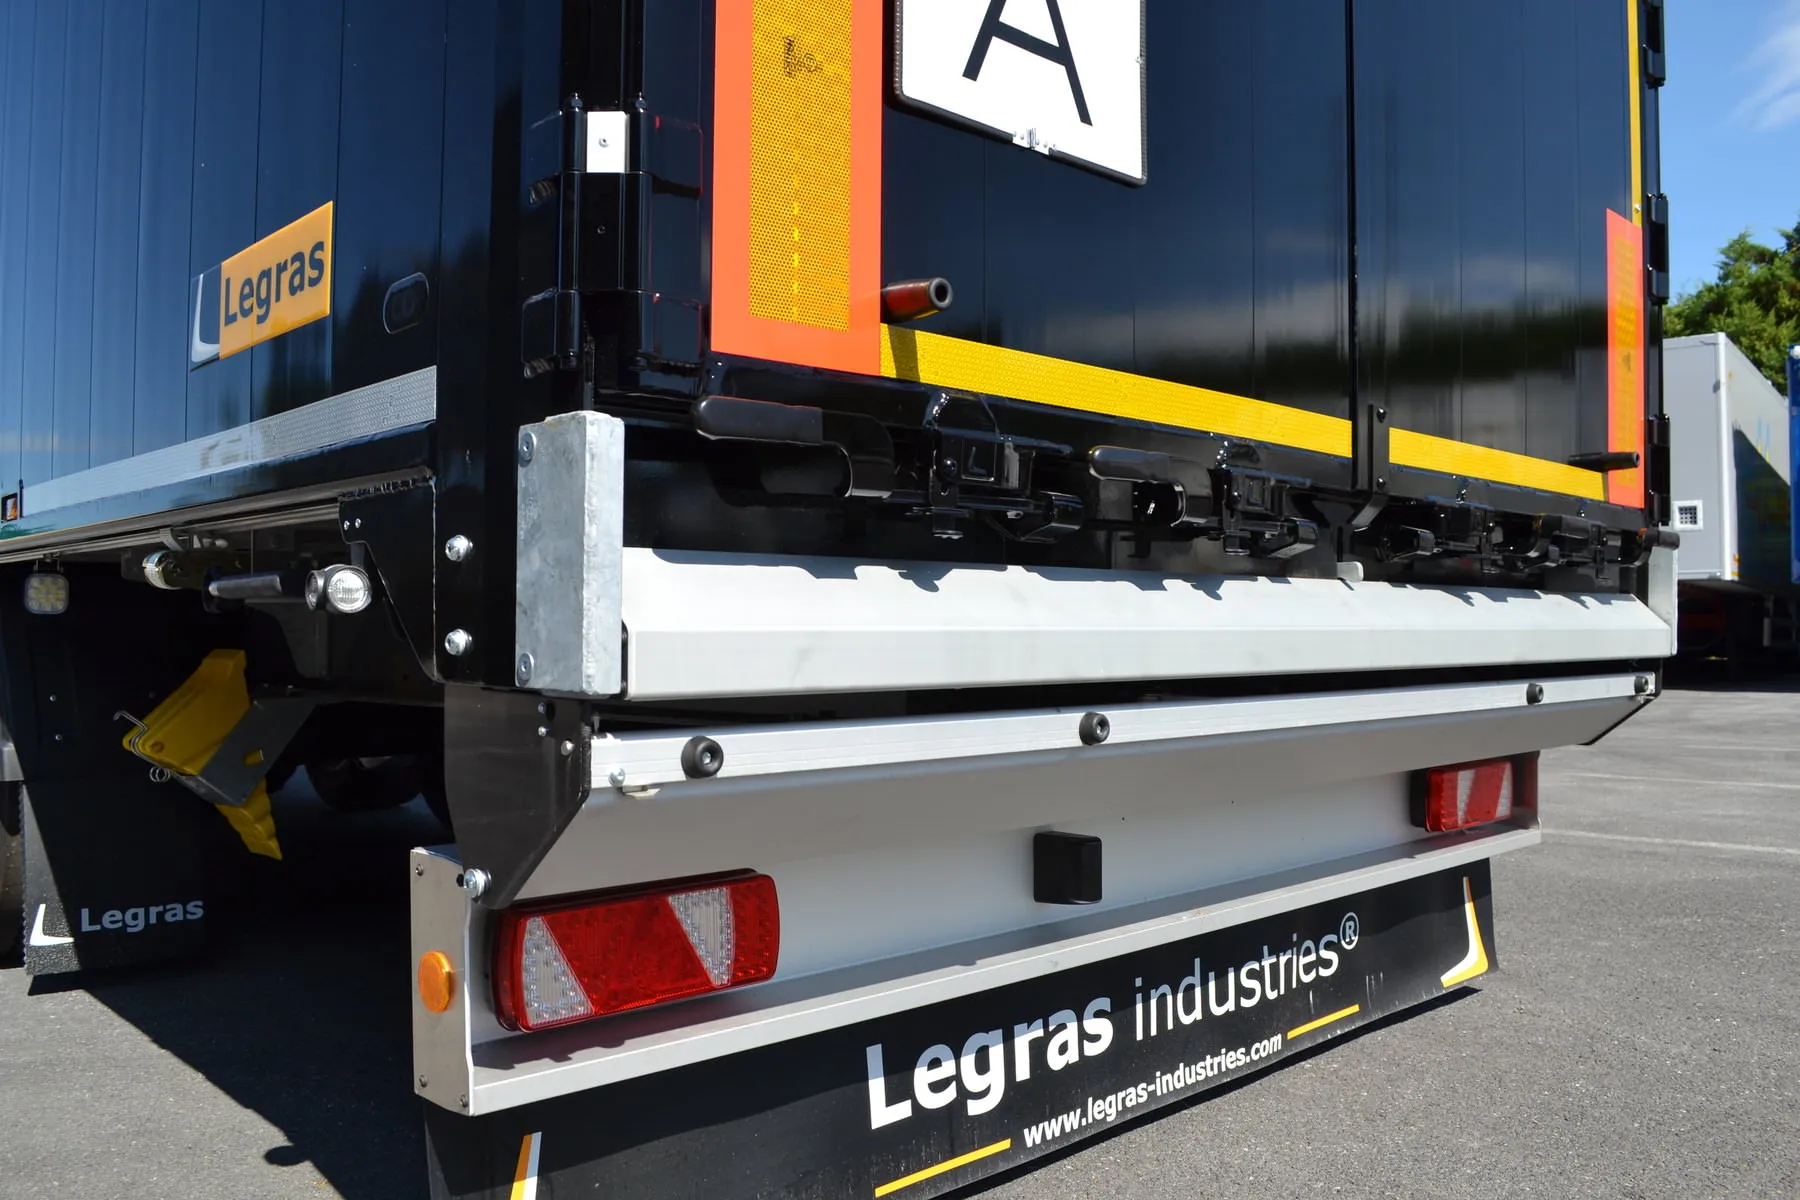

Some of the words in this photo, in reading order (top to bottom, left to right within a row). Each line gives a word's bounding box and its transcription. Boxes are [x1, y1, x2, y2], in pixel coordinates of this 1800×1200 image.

[962, 0, 1093, 127] A
[224, 241, 325, 327] Legras
[80, 900, 205, 933] Legras
[866, 997, 1114, 1130] Legras
[1024, 1033, 1282, 1148] www.legras-industries.com
